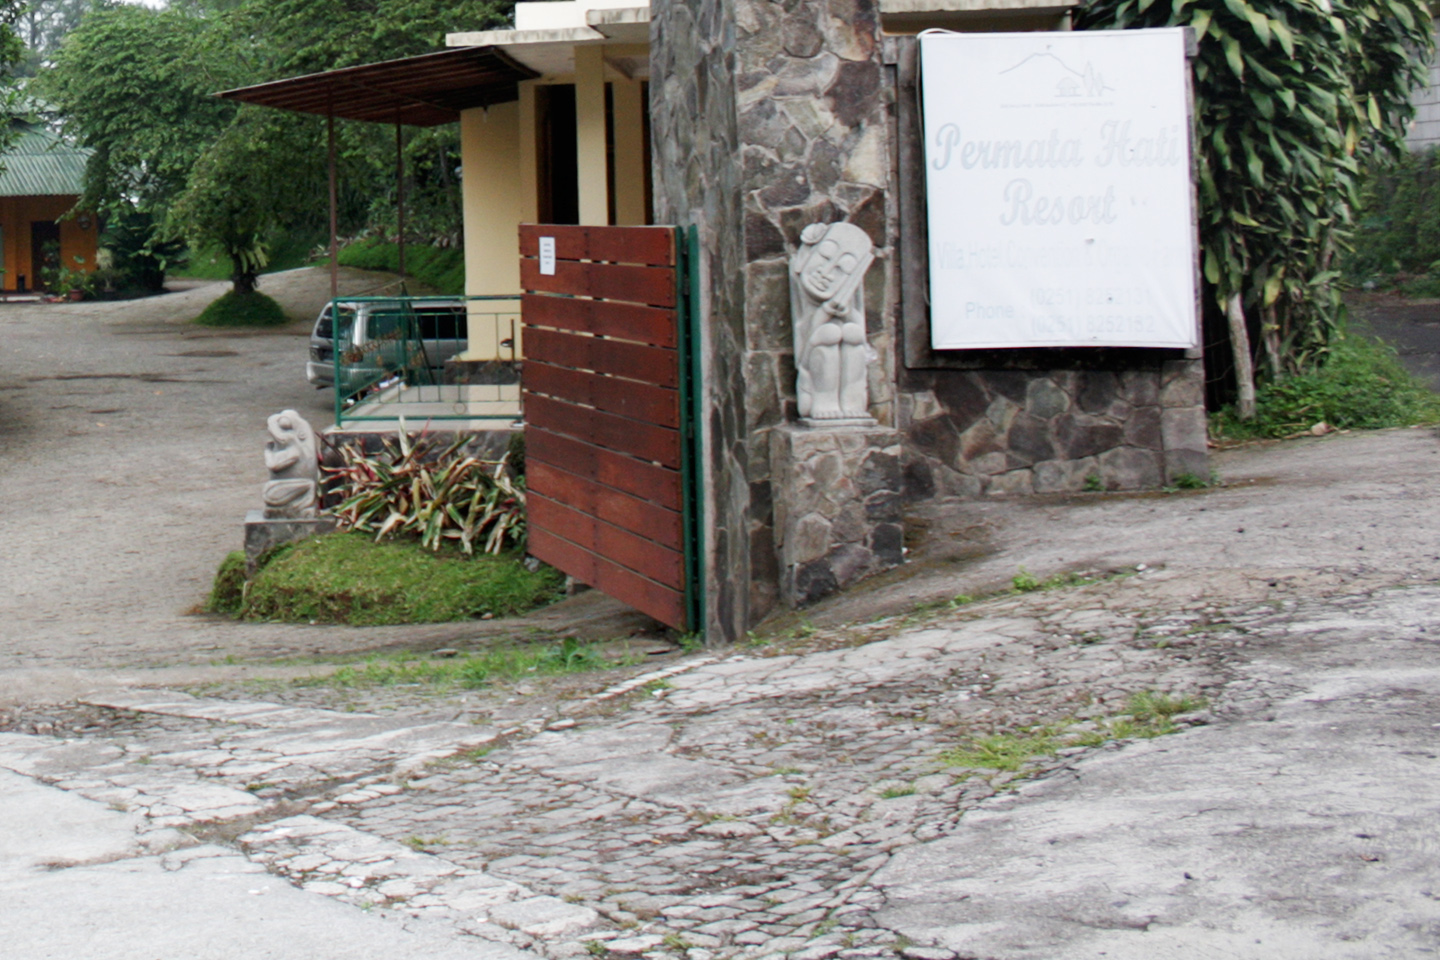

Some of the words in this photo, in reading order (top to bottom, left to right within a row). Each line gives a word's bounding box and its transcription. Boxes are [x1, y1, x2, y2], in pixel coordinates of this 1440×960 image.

[931, 122, 1085, 171] Permata
[1094, 119, 1181, 168] Hati
[1000, 178, 1118, 227] Resort
[965, 301, 1014, 319] Phone
